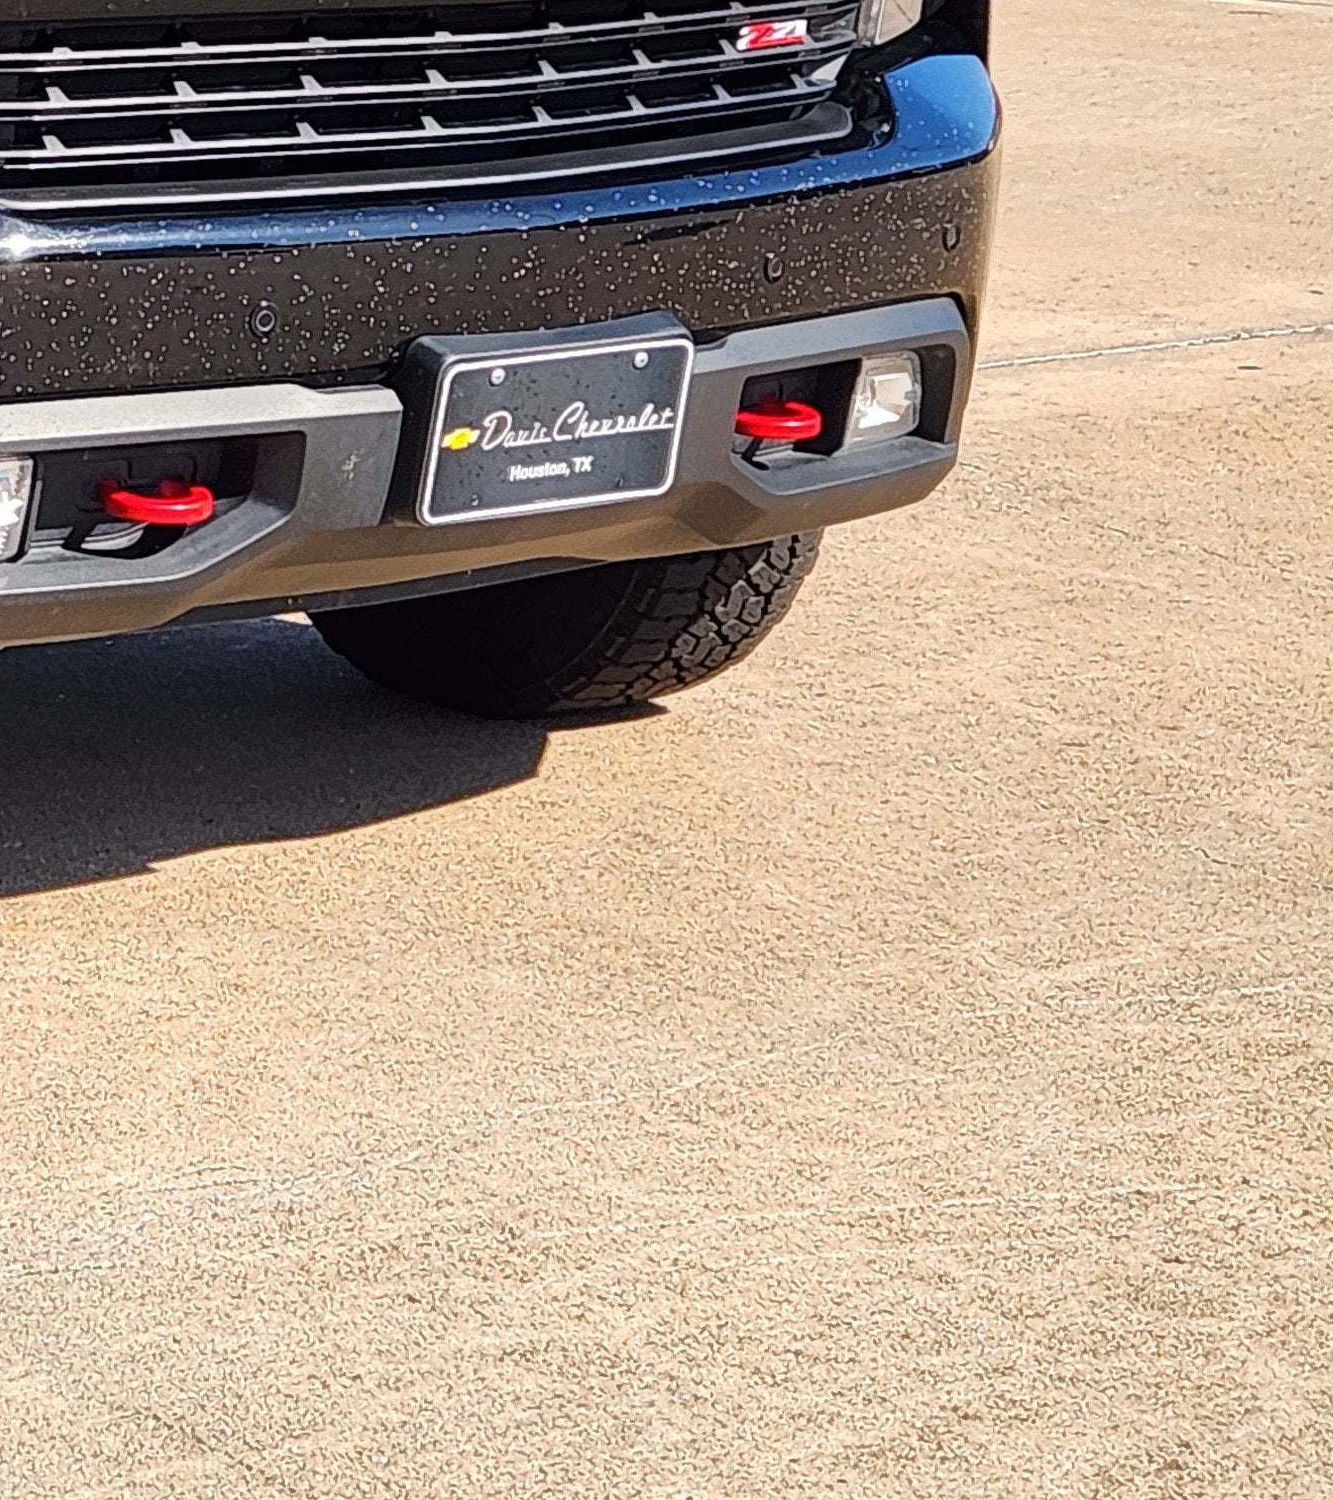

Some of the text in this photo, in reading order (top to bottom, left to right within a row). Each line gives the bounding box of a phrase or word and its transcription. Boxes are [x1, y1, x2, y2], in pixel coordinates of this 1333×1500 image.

[480, 400, 675, 451] Davis Chevrolet
[509, 455, 595, 483] Houston, TX
